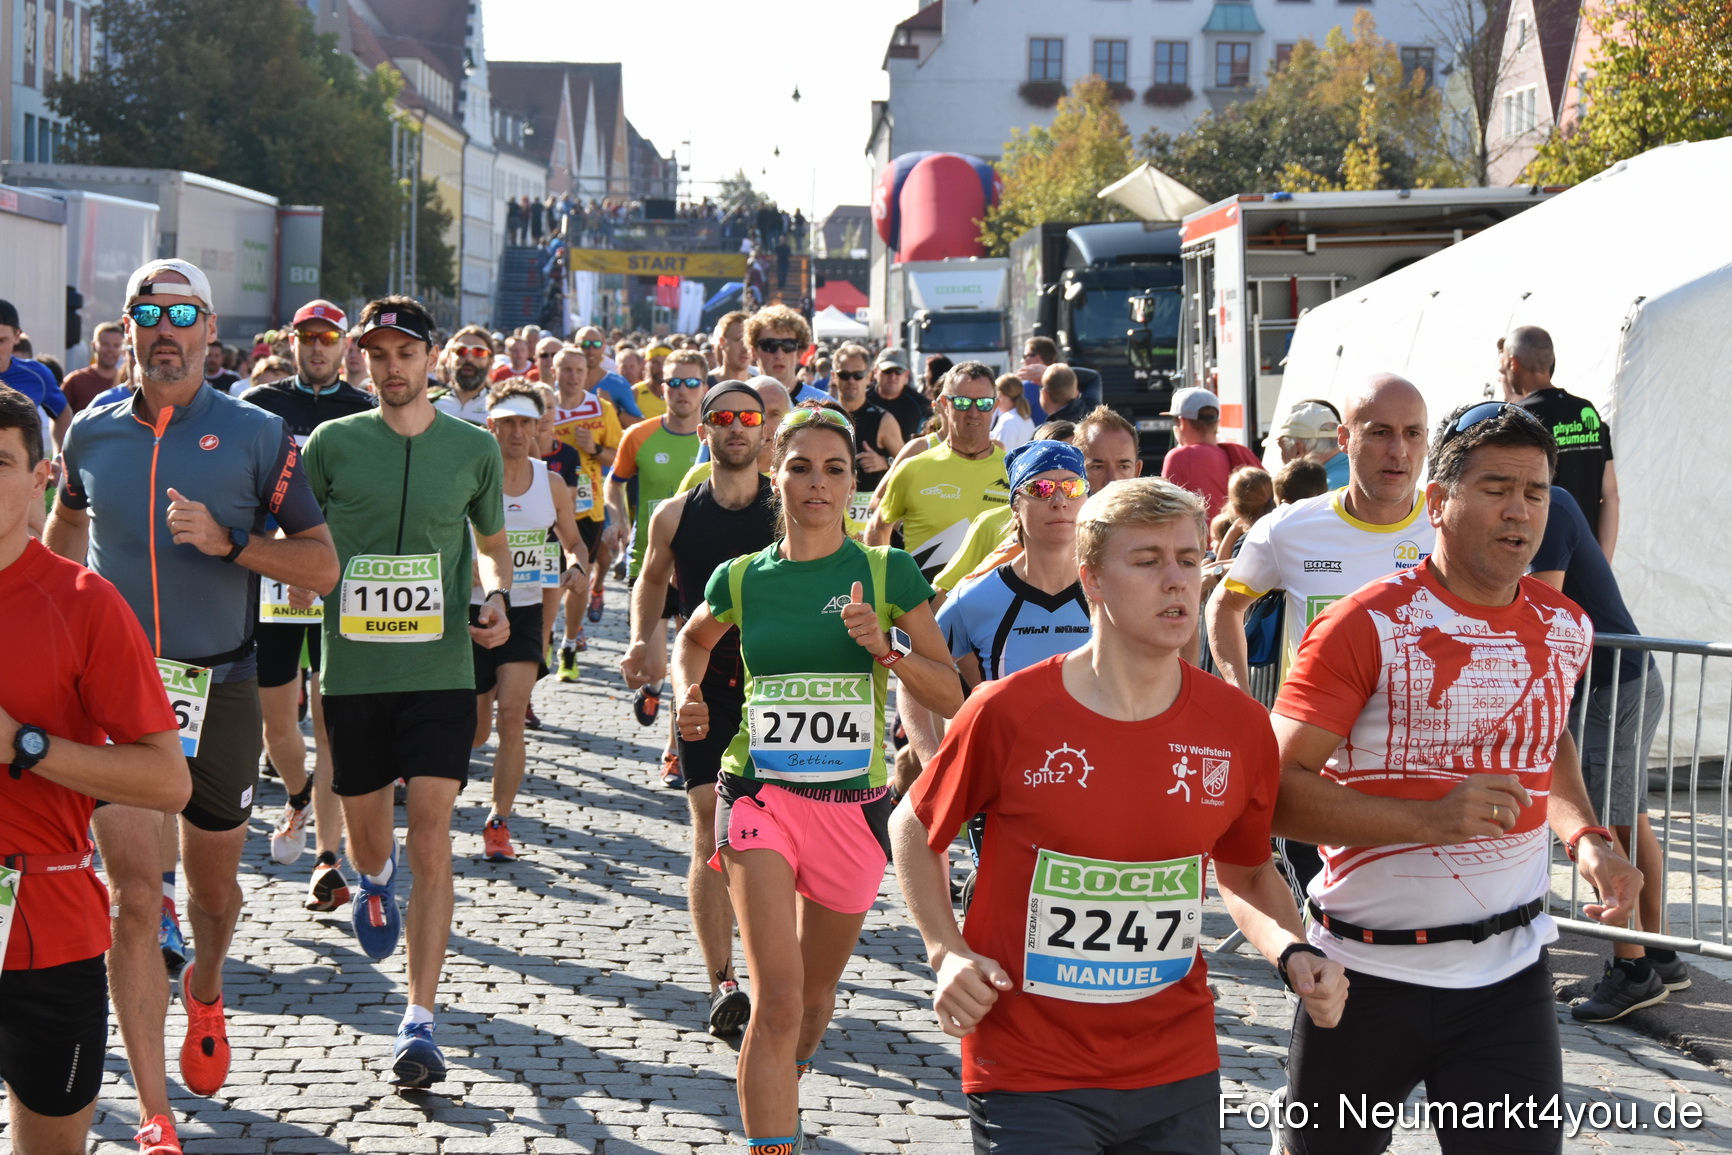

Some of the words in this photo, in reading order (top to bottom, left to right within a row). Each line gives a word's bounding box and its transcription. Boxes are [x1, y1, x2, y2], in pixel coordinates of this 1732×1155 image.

[628, 256, 687, 270] START
[1553, 420, 1582, 437] physio
[1556, 431, 1599, 446] neumarkt
[507, 531, 540, 544] OCK
[514, 550, 536, 568] 04
[1397, 546, 1418, 560] 20
[351, 559, 432, 578] BOCK
[1304, 560, 1342, 570] BOCK
[354, 586, 431, 612] 1102
[366, 621, 418, 632] EUGEN
[1456, 624, 1488, 635] 10.54
[158, 665, 197, 692] CK
[759, 678, 863, 701] BOCK
[1472, 697, 1504, 709] 26.22
[172, 700, 191, 729] 6
[763, 711, 860, 743] 2704
[1168, 743, 1187, 753] TSV
[1189, 745, 1231, 758] Wolfstein
[788, 753, 843, 766] Bettina
[1023, 767, 1065, 788] Spitz
[1045, 858, 1188, 897] BOCK
[1048, 907, 1181, 952] 2247
[1187, 911, 1194, 920] C
[1057, 963, 1162, 985] MANUEL
